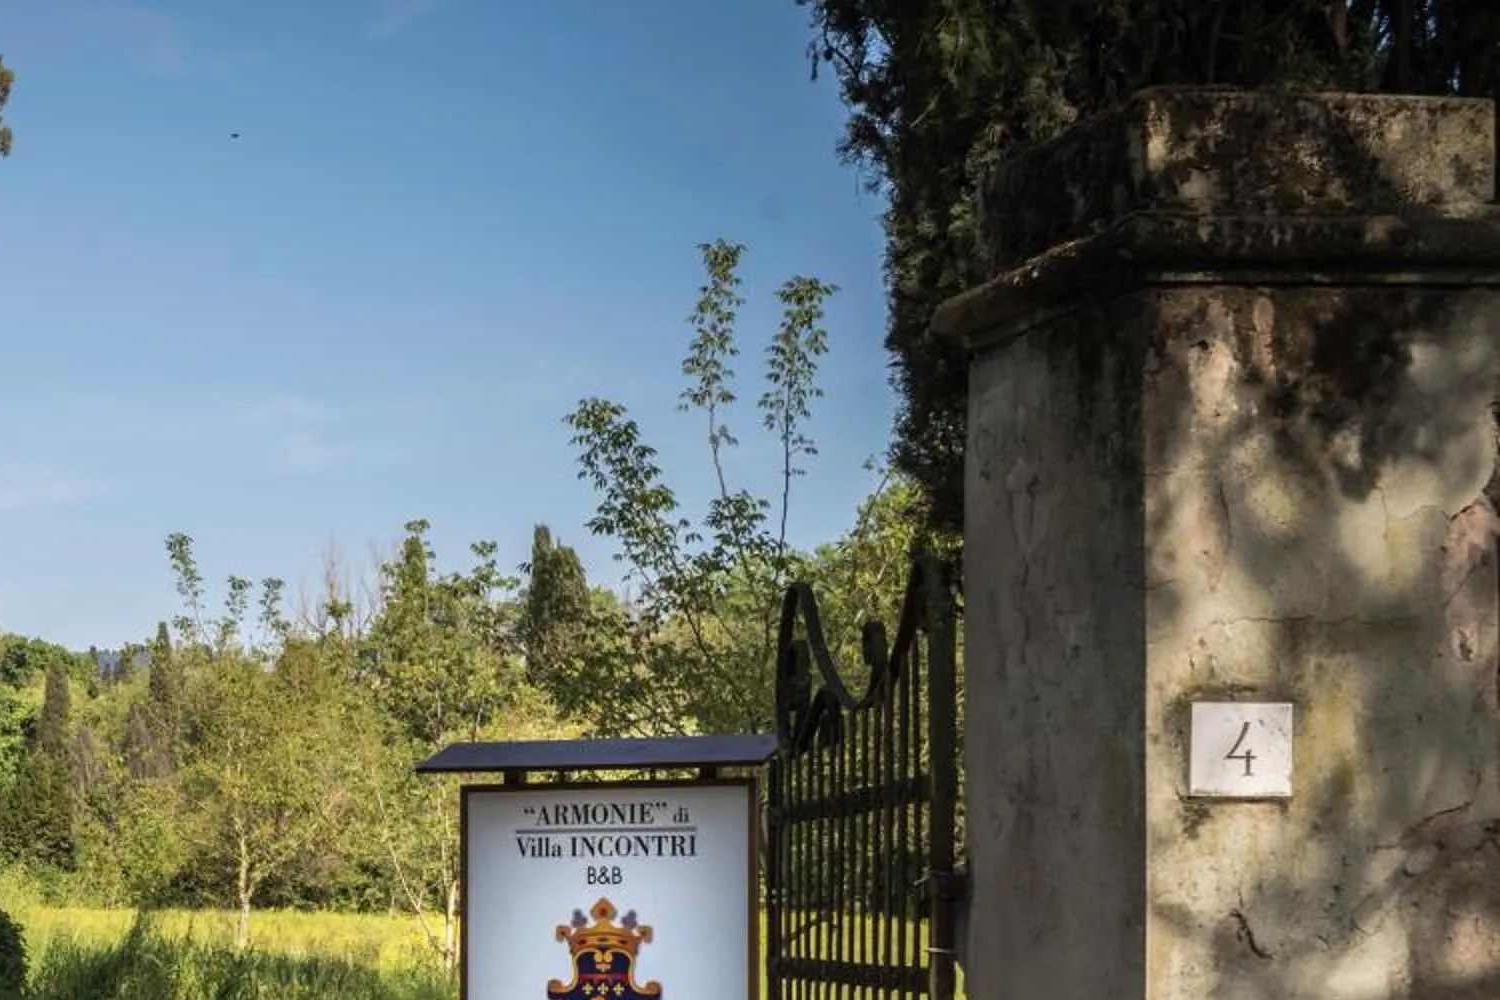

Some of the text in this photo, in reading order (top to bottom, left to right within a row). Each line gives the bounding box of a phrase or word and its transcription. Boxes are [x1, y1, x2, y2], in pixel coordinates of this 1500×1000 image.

[1222, 721, 1258, 777] 4
[673, 807, 690, 824] di
[516, 835, 697, 858] Villa INCONTRI
[586, 866, 623, 885] B&B
